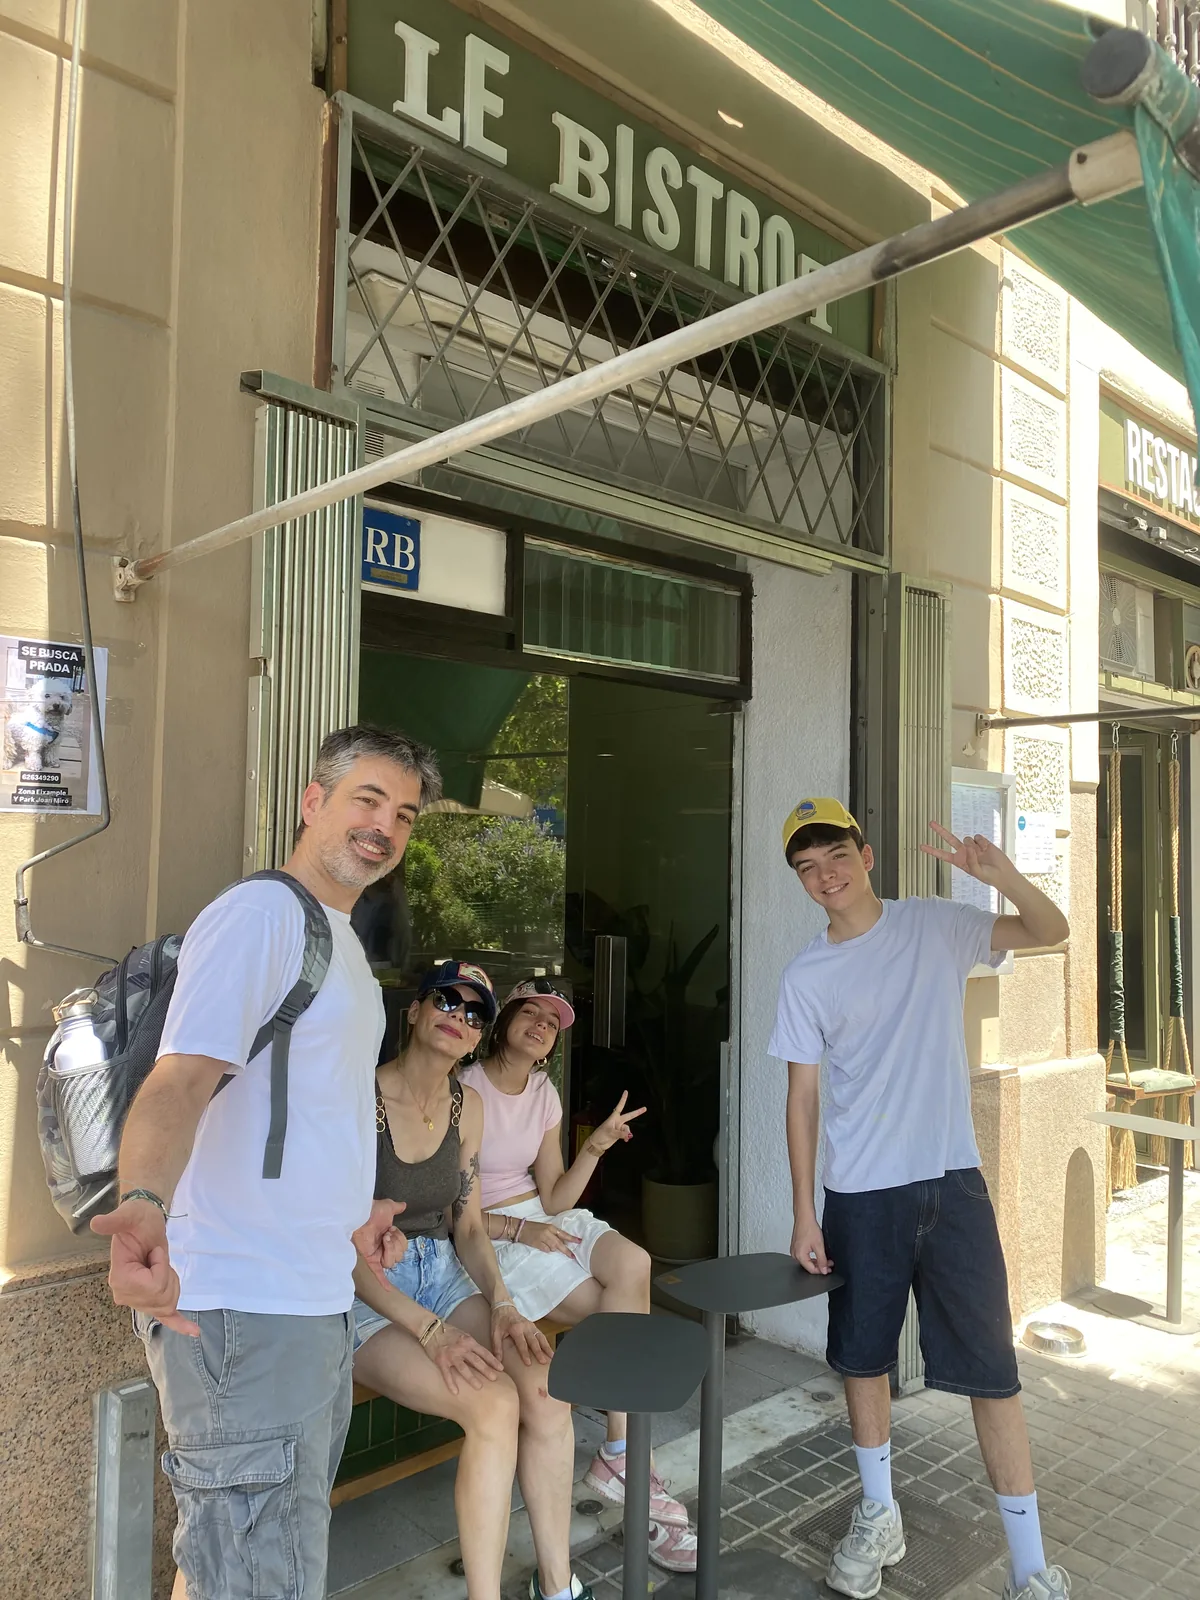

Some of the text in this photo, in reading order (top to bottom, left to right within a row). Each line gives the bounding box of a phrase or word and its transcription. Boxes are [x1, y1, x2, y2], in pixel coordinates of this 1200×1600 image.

[393, 20, 510, 168] LE
[363, 526, 416, 571] RB
[21, 645, 79, 662] SE BUSCA
[29, 660, 71, 674] PRADA
